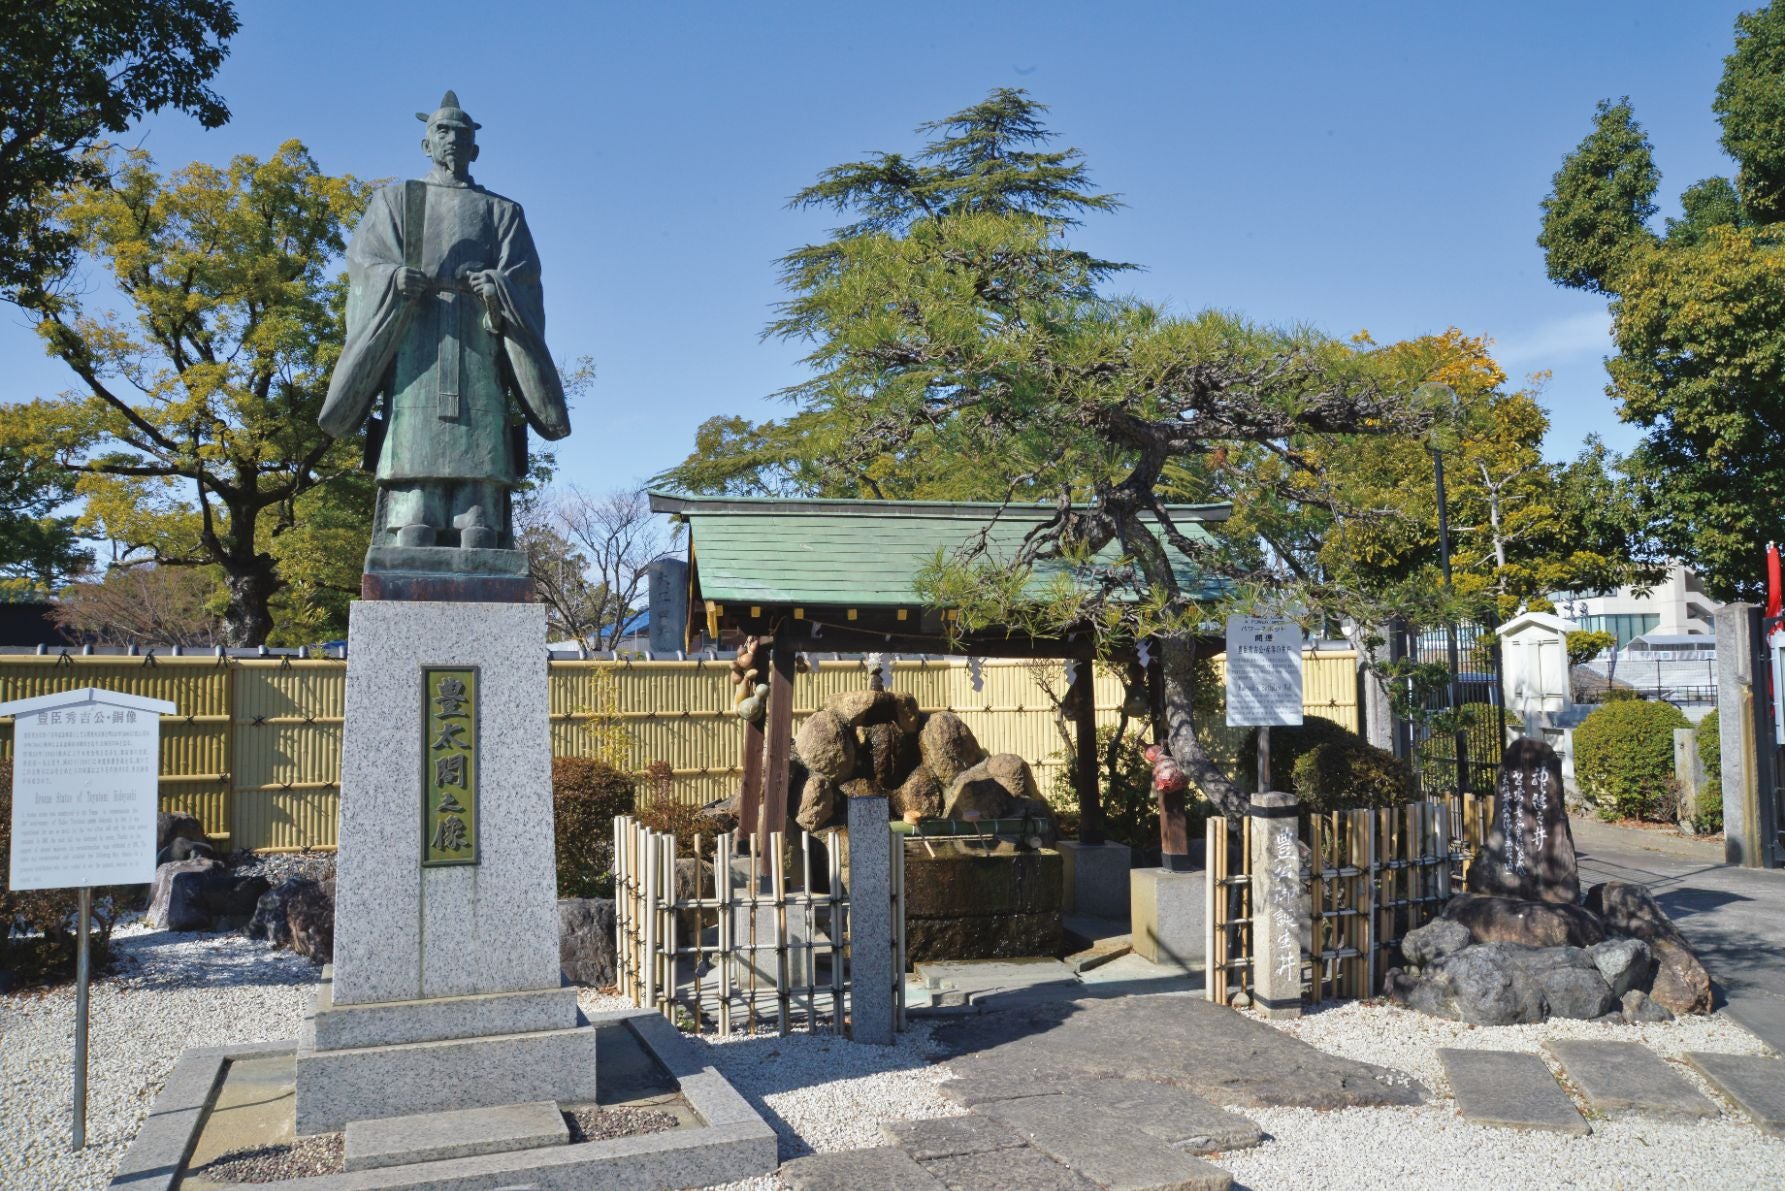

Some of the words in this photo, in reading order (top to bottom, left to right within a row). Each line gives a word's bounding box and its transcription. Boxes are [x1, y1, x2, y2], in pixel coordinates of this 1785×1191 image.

[431, 676, 473, 852] 豊太閤之像
